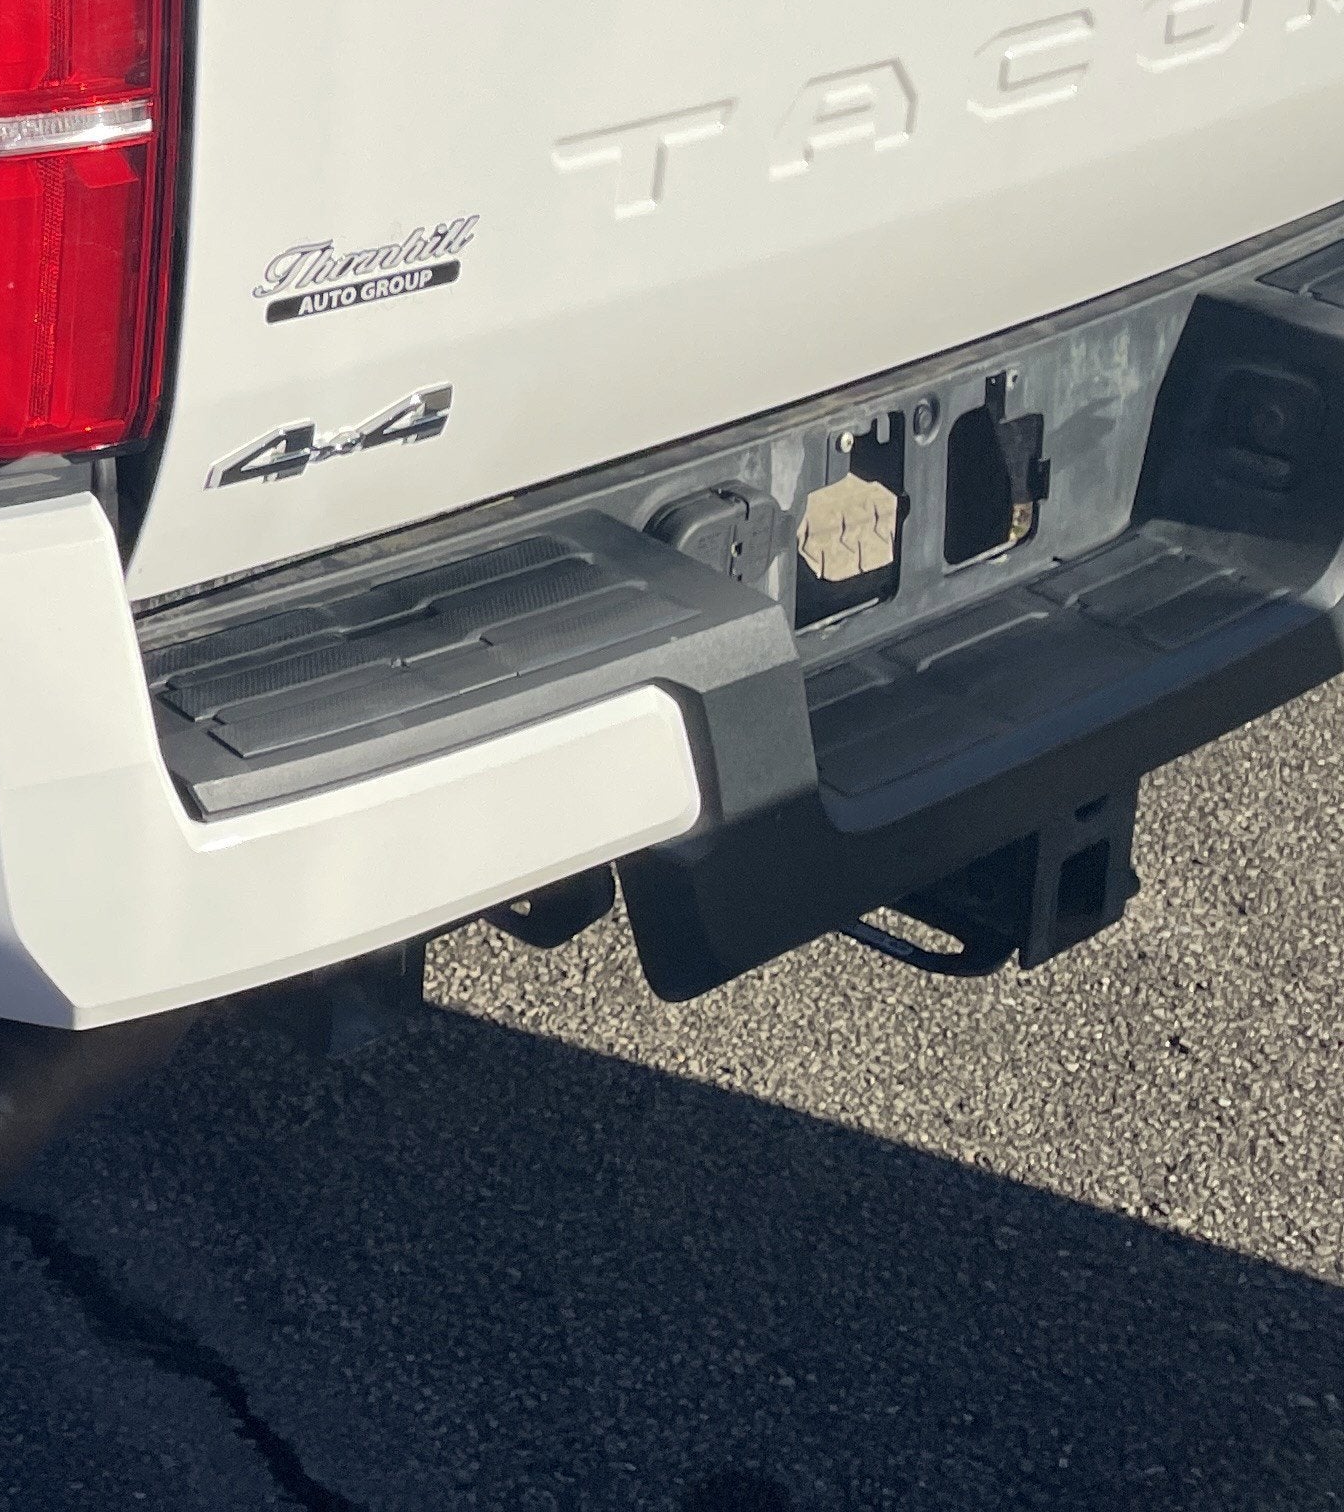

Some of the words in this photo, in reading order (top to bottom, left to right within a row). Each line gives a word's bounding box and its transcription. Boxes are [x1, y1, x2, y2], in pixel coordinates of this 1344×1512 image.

[252, 214, 480, 299] Thornhill
[298, 288, 357, 316] AUTO
[360, 268, 434, 302] GROUP
